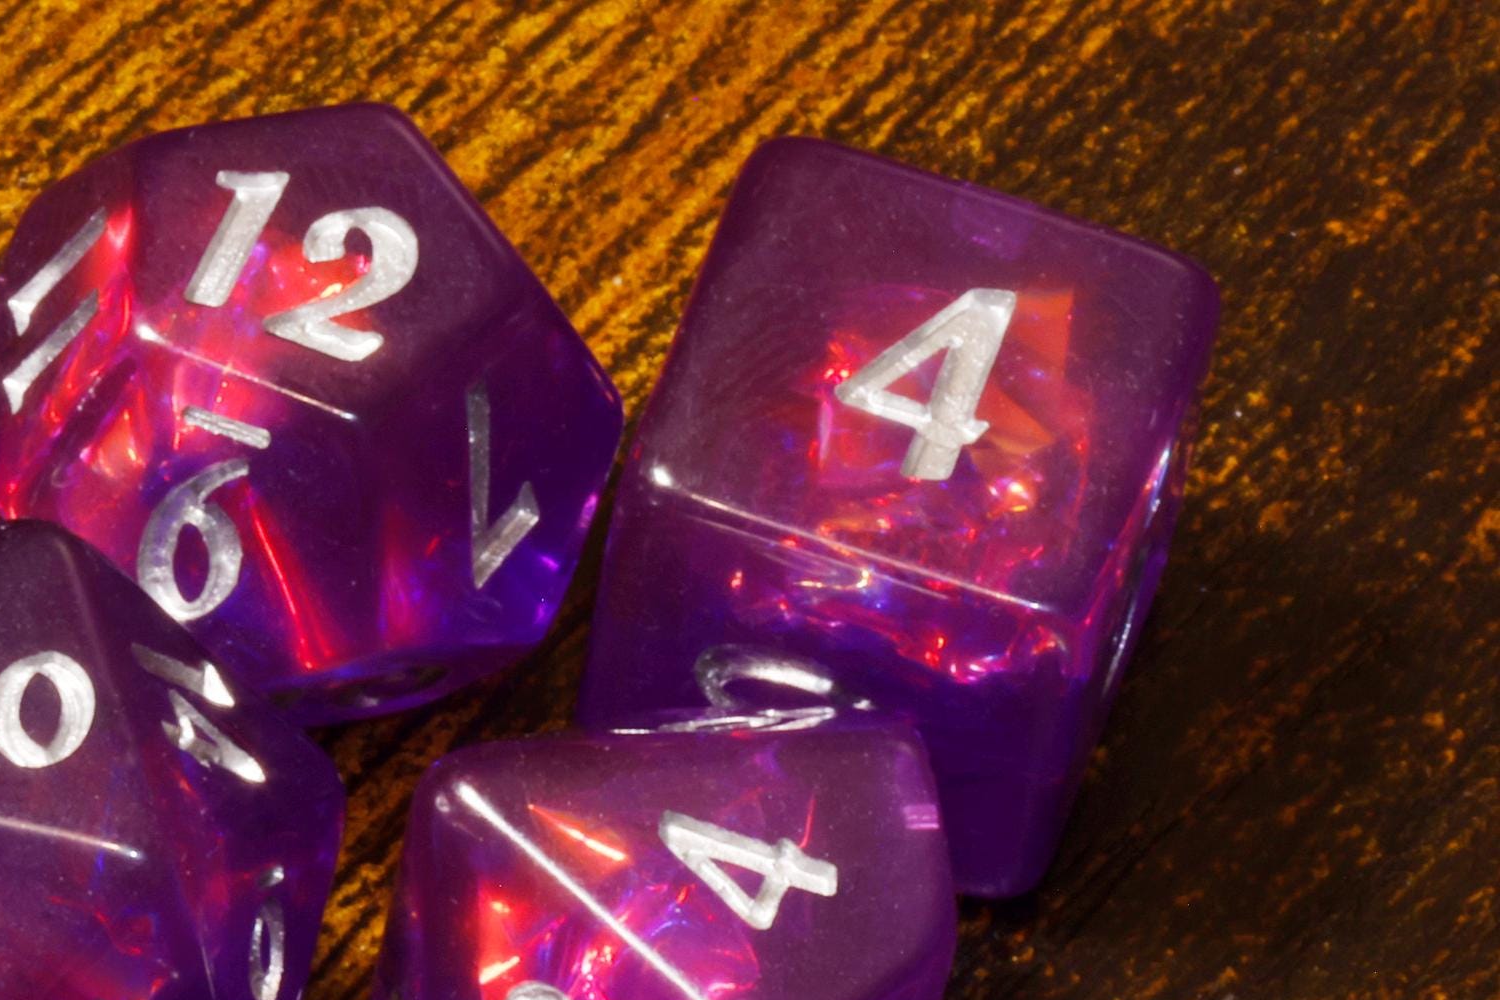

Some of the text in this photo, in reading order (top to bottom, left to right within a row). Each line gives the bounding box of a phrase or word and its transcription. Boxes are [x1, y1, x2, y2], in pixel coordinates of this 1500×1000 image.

[185, 170, 420, 362] 12
[834, 288, 1016, 480] 4
[657, 810, 838, 929] 4
